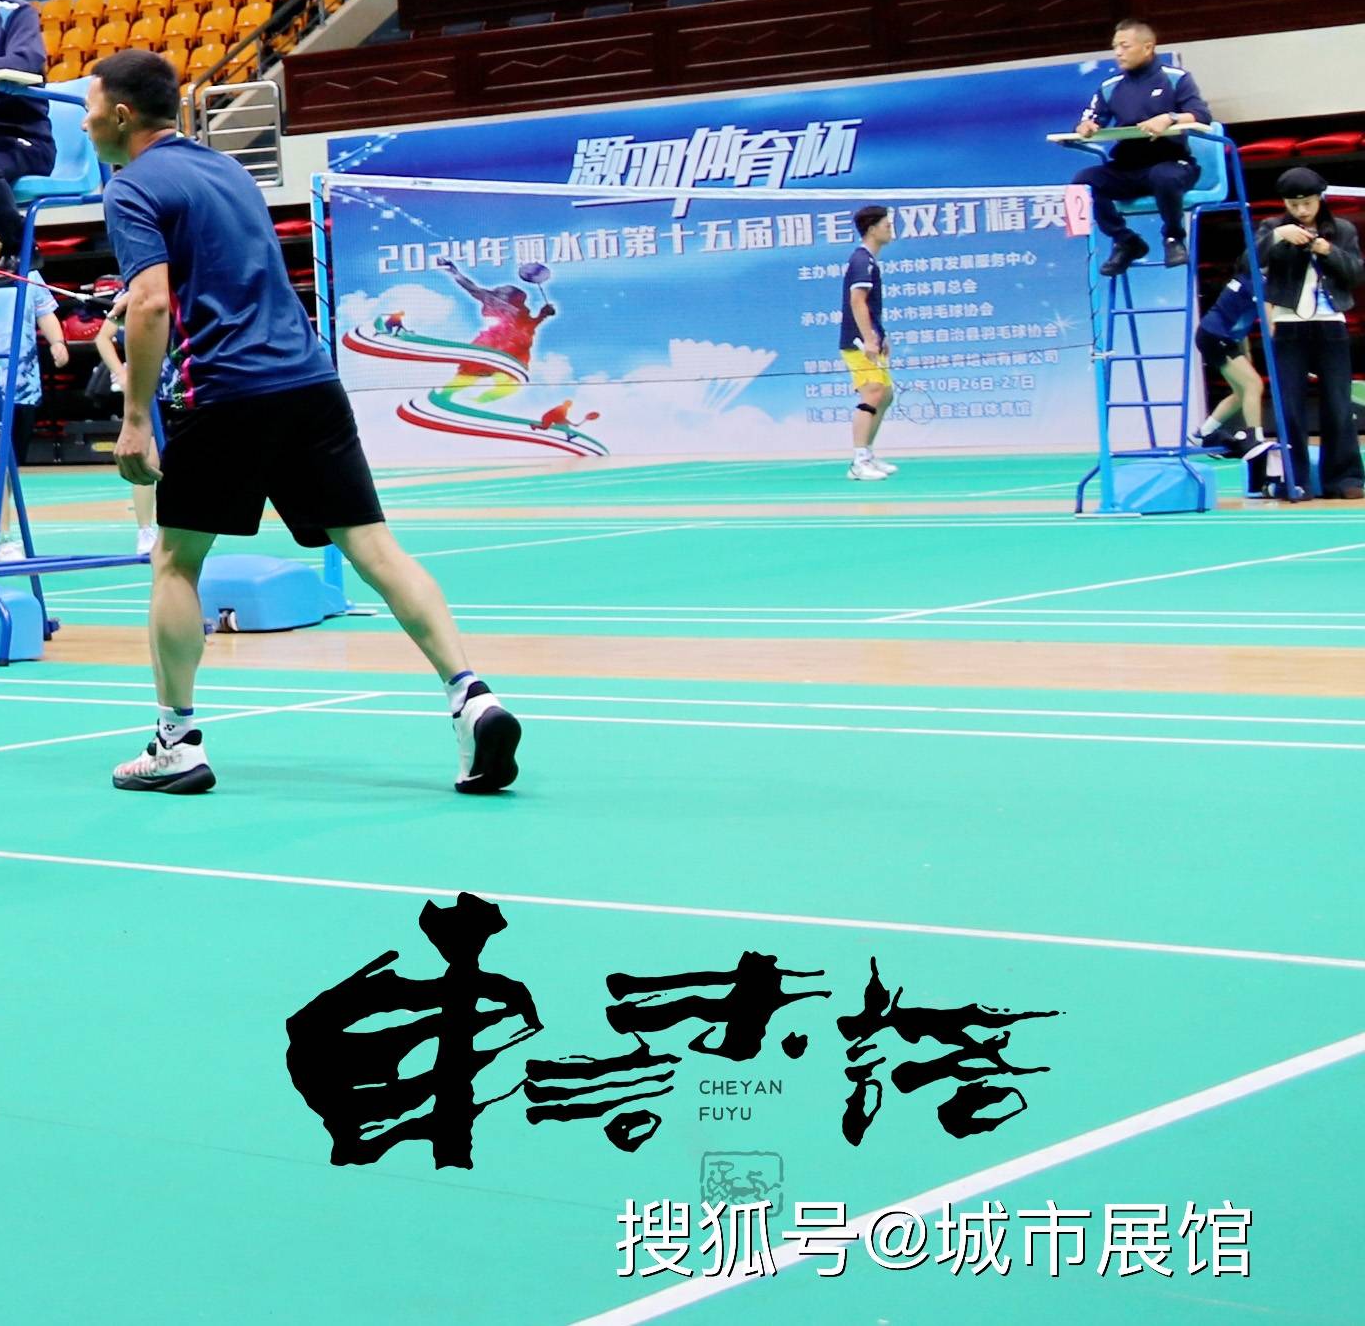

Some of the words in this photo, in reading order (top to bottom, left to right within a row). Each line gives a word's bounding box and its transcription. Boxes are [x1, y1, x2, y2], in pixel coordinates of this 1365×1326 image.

[1074, 195, 1086, 221] 2
[378, 195, 1066, 274] 2024年丽水市第十五届羽毛双打精英
[800, 310, 843, 327] 承办单
